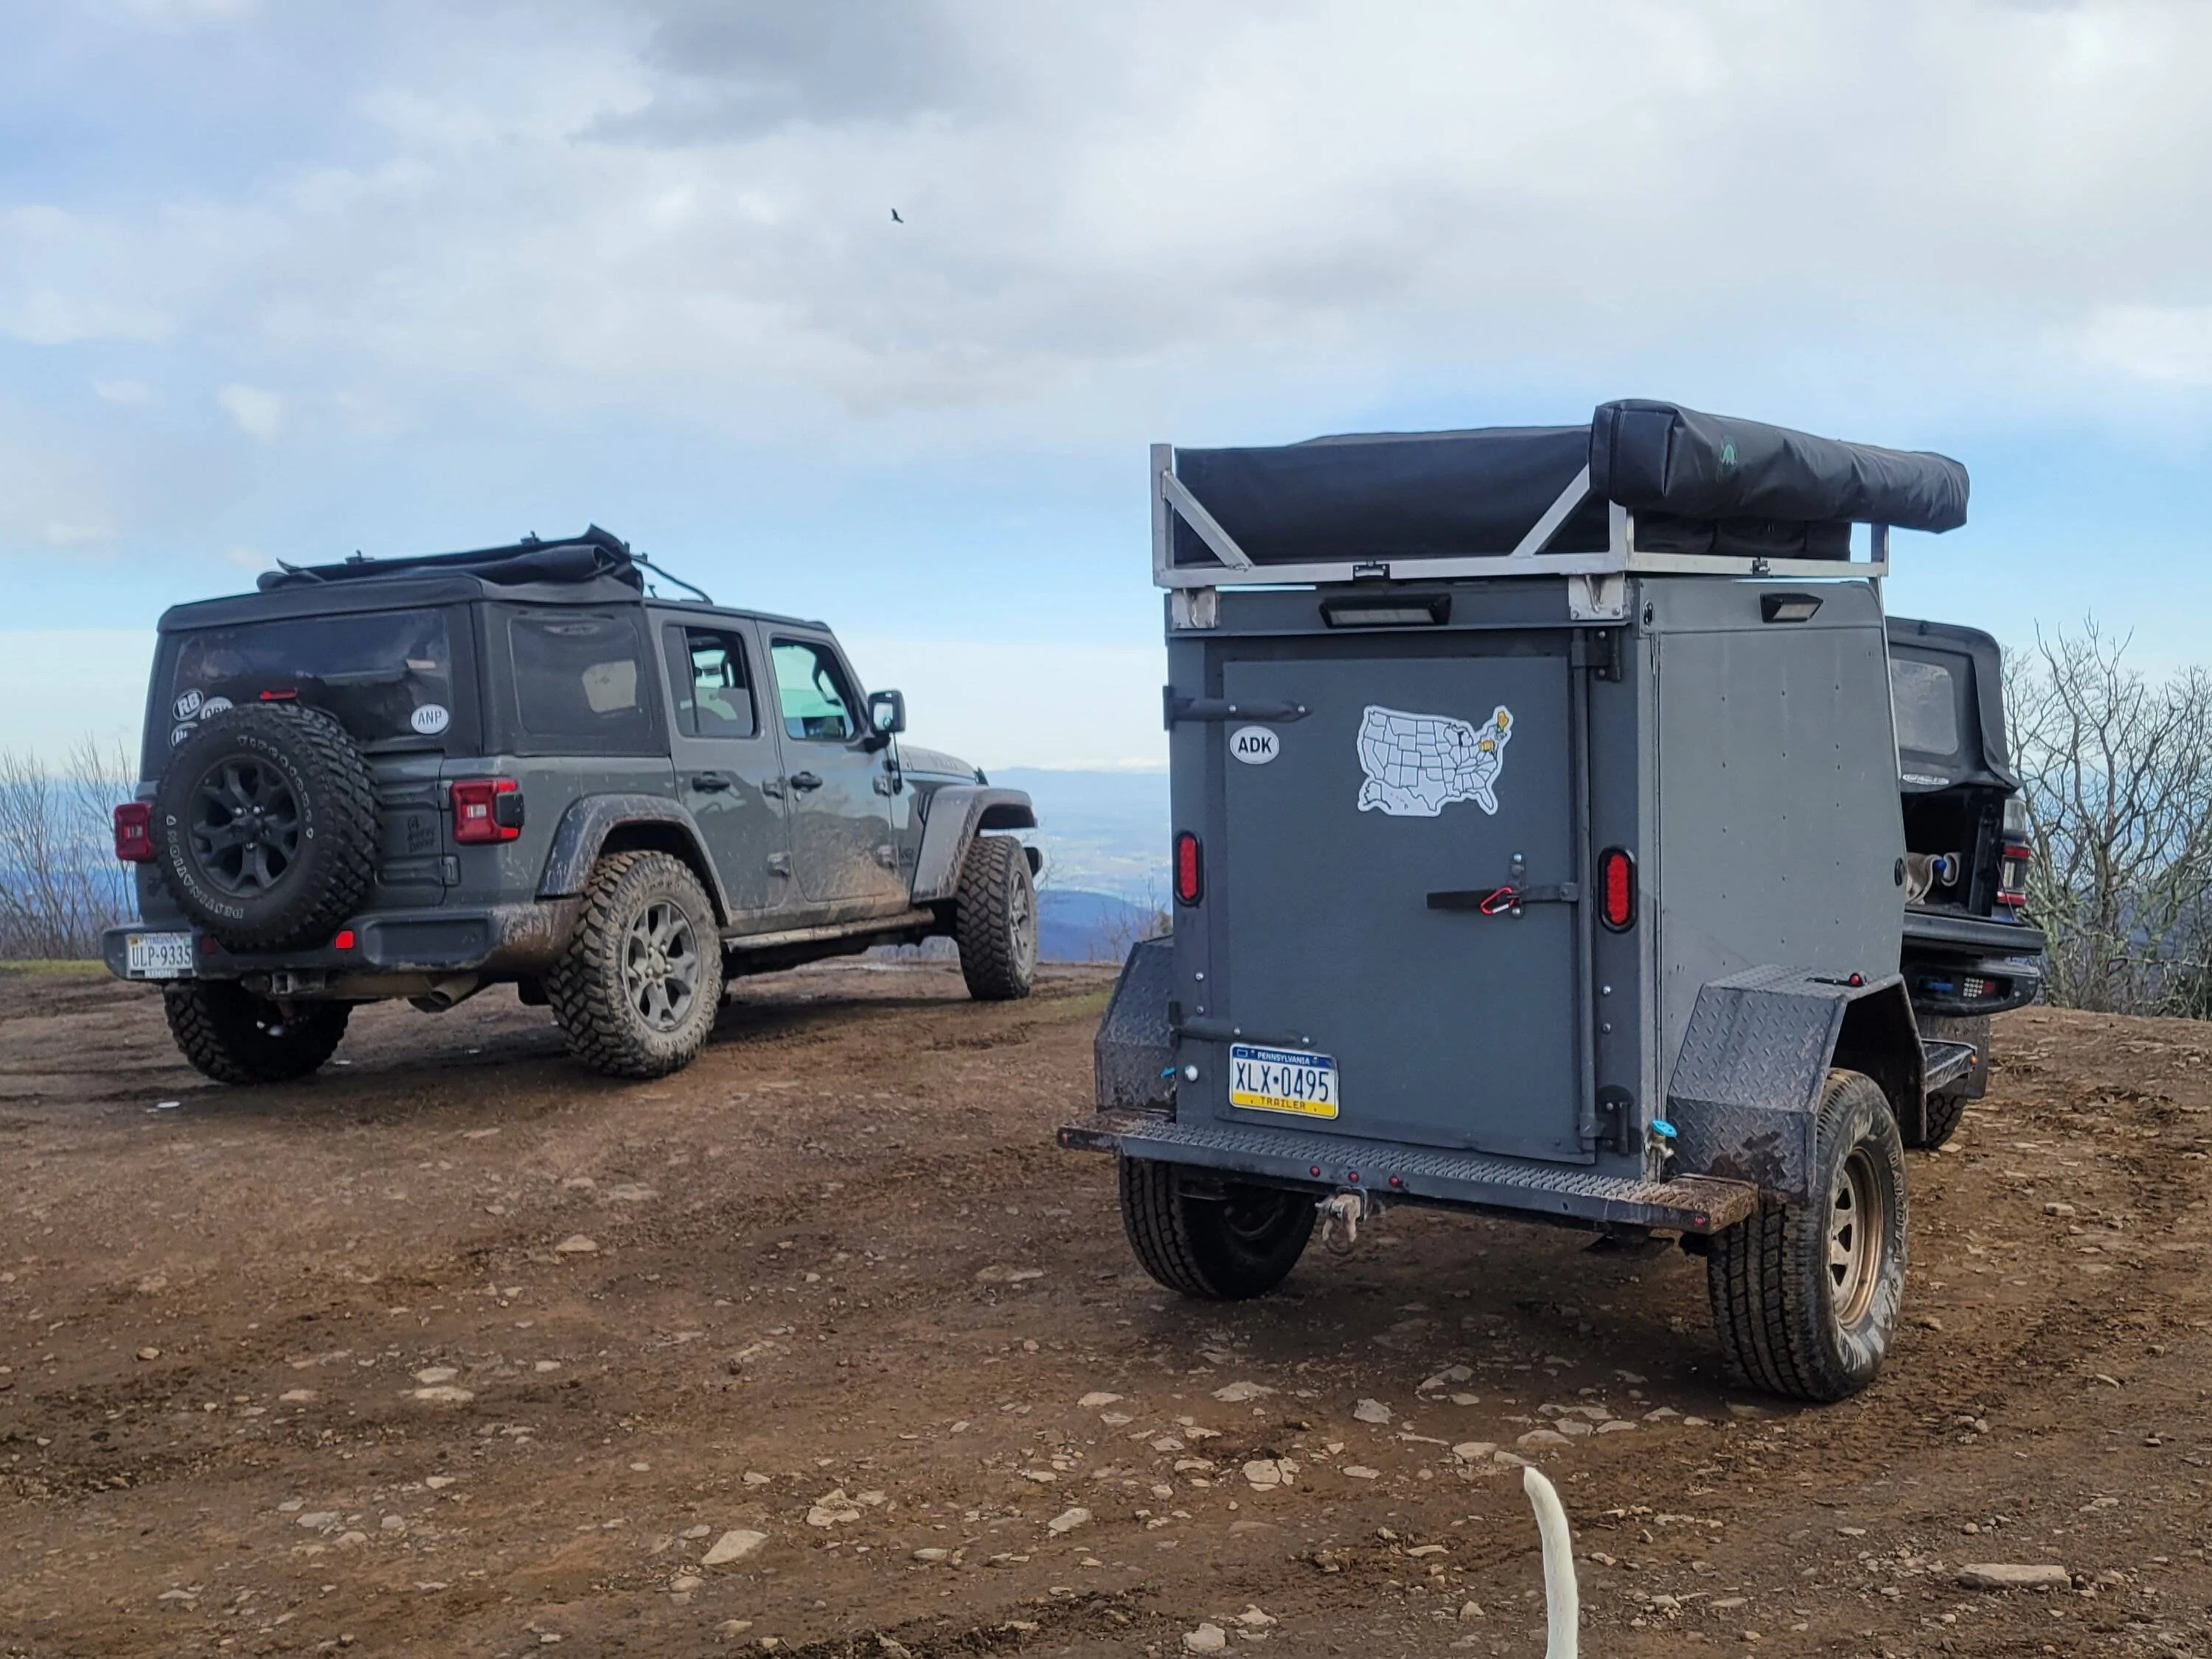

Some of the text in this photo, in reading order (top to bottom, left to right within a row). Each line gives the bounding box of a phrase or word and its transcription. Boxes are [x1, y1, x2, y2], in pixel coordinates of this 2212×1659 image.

[178, 692, 200, 717] RB
[417, 710, 442, 726] ANP
[1238, 736, 1272, 754] ADK
[167, 830, 244, 919] DESTINATION
[132, 945, 192, 967] ULP-9335
[1257, 1051, 1310, 1065] PENNSYLVANIA
[1259, 1096, 1306, 1110] TRAILER
